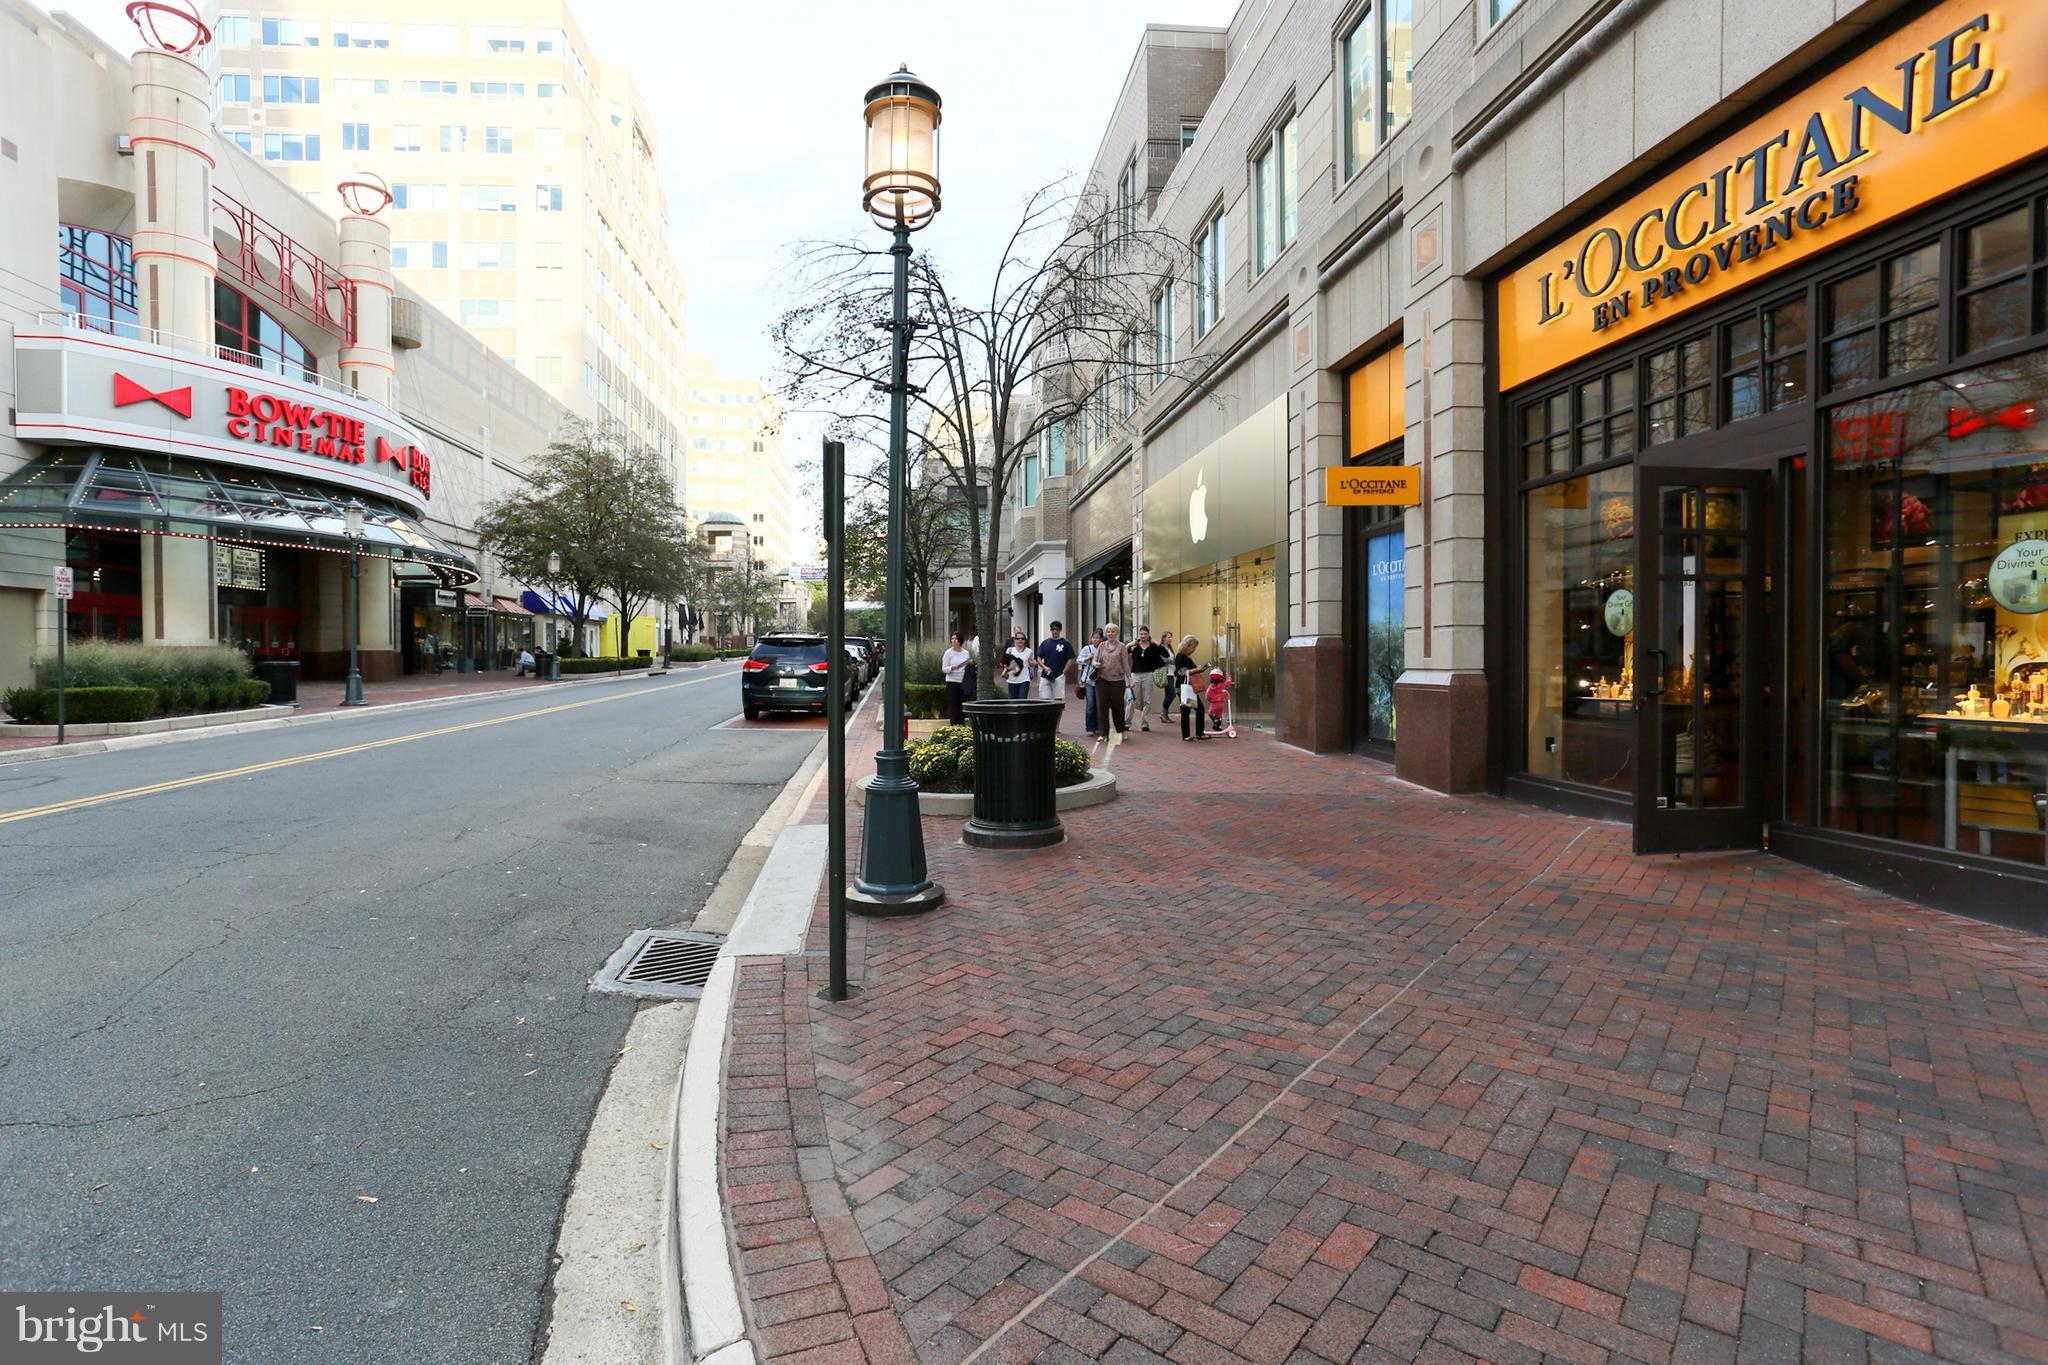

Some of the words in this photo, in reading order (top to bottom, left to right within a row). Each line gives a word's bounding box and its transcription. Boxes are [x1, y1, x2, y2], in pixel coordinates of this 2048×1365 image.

[1537, 13, 1995, 326] L'OCCITANE
[1592, 289, 1630, 332] EN
[1641, 174, 1860, 308] PROVENCE
[228, 417, 366, 464] CINEMAS
[1340, 478, 1407, 490] L'OCCITANE
[1997, 559, 2035, 570] Divine
[2016, 548, 2045, 558] Your
